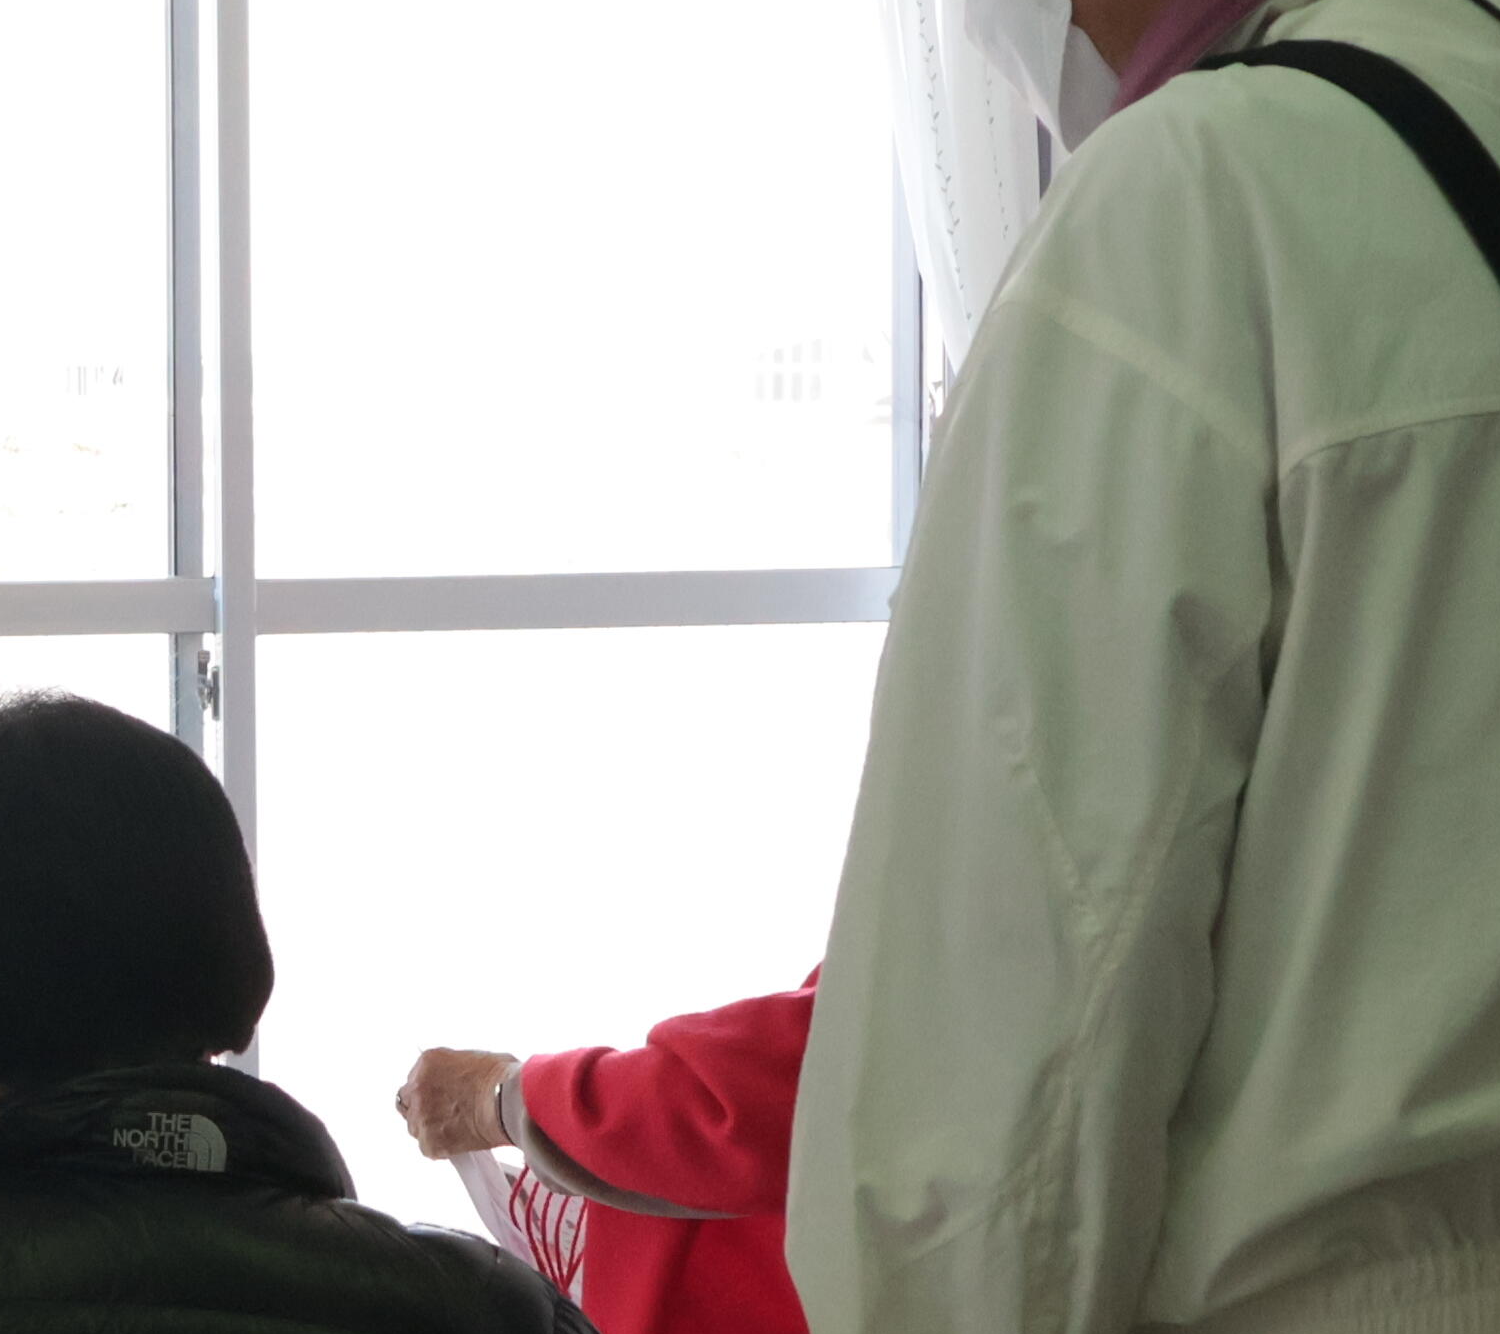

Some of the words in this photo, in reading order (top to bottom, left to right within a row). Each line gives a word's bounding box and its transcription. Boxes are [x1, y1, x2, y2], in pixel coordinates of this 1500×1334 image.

[147, 1112, 191, 1133] THE
[113, 1128, 189, 1151] NORTH
[132, 1149, 188, 1169] FACE
